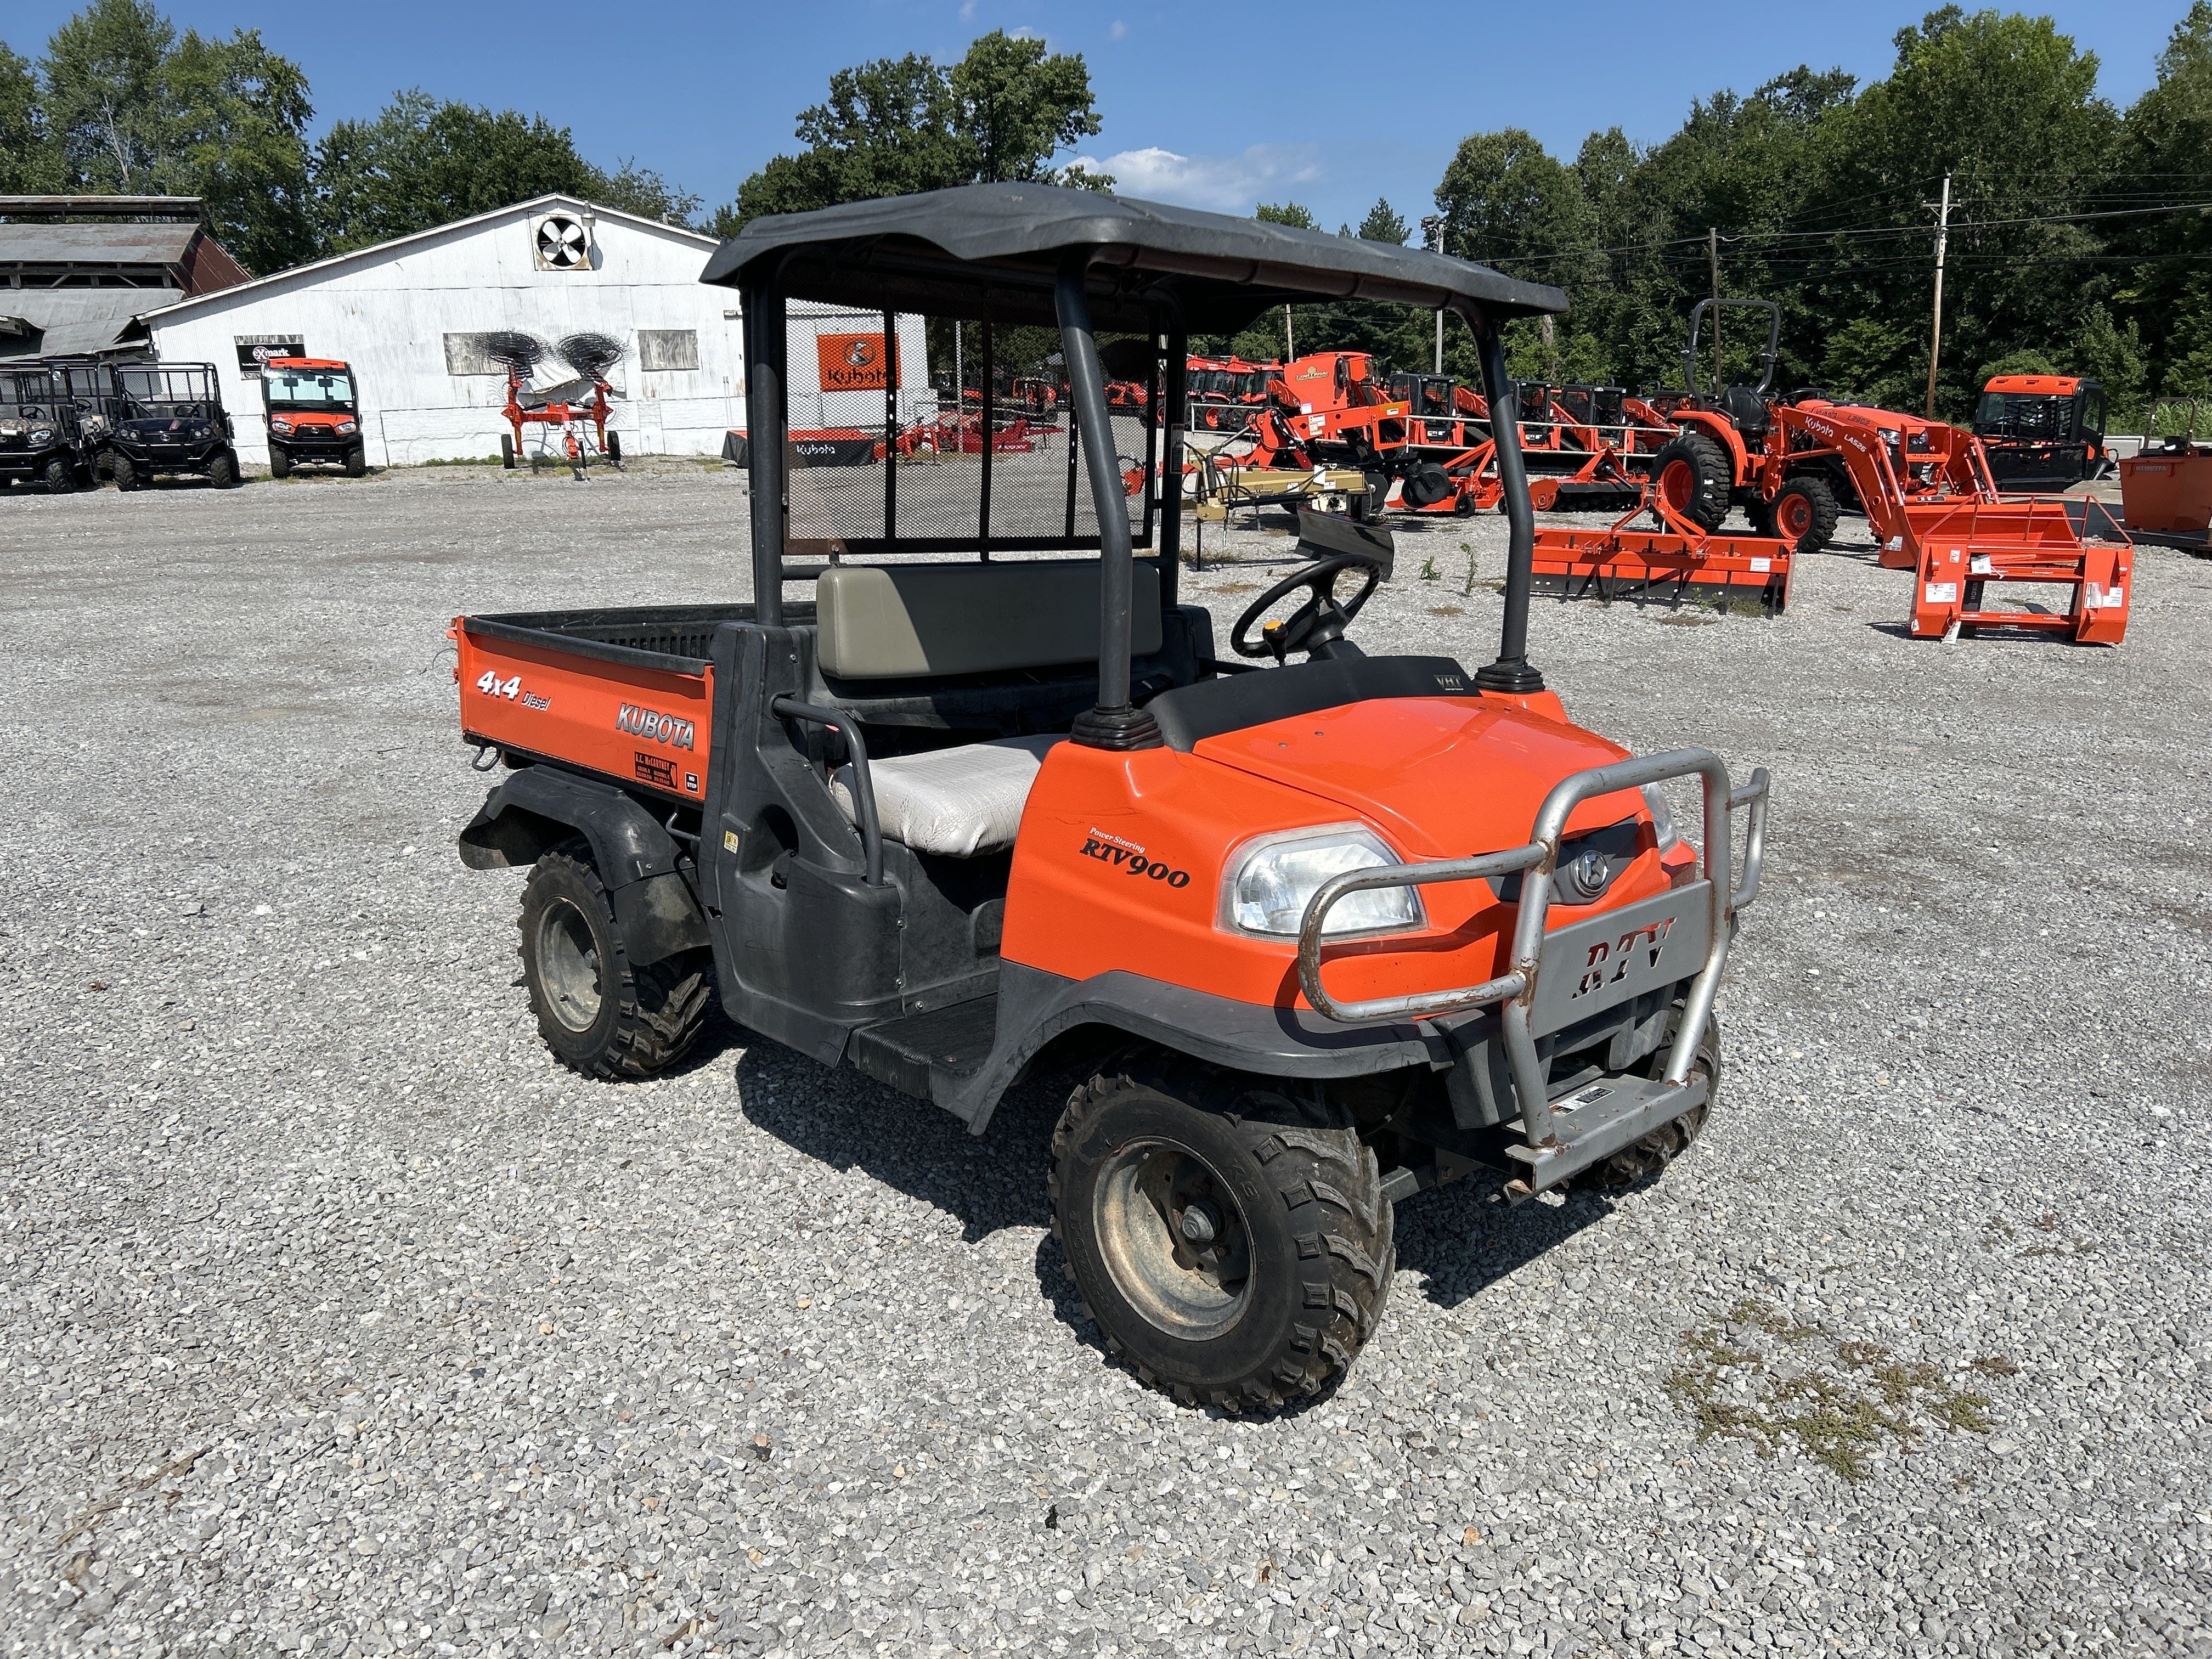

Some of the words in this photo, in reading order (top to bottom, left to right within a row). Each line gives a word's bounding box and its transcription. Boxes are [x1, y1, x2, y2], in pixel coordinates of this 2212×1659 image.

[1805, 416, 1833, 438] Kubota
[797, 444, 835, 455] Kubota
[1844, 433, 1866, 453] LA526
[521, 691, 552, 712] Diesel
[616, 702, 695, 752] KUBOTA
[1090, 827, 1114, 841] Power
[1113, 836, 1146, 854] Steering
[1079, 838, 1190, 889] RTV900
[1571, 916, 1677, 1000] RTV
